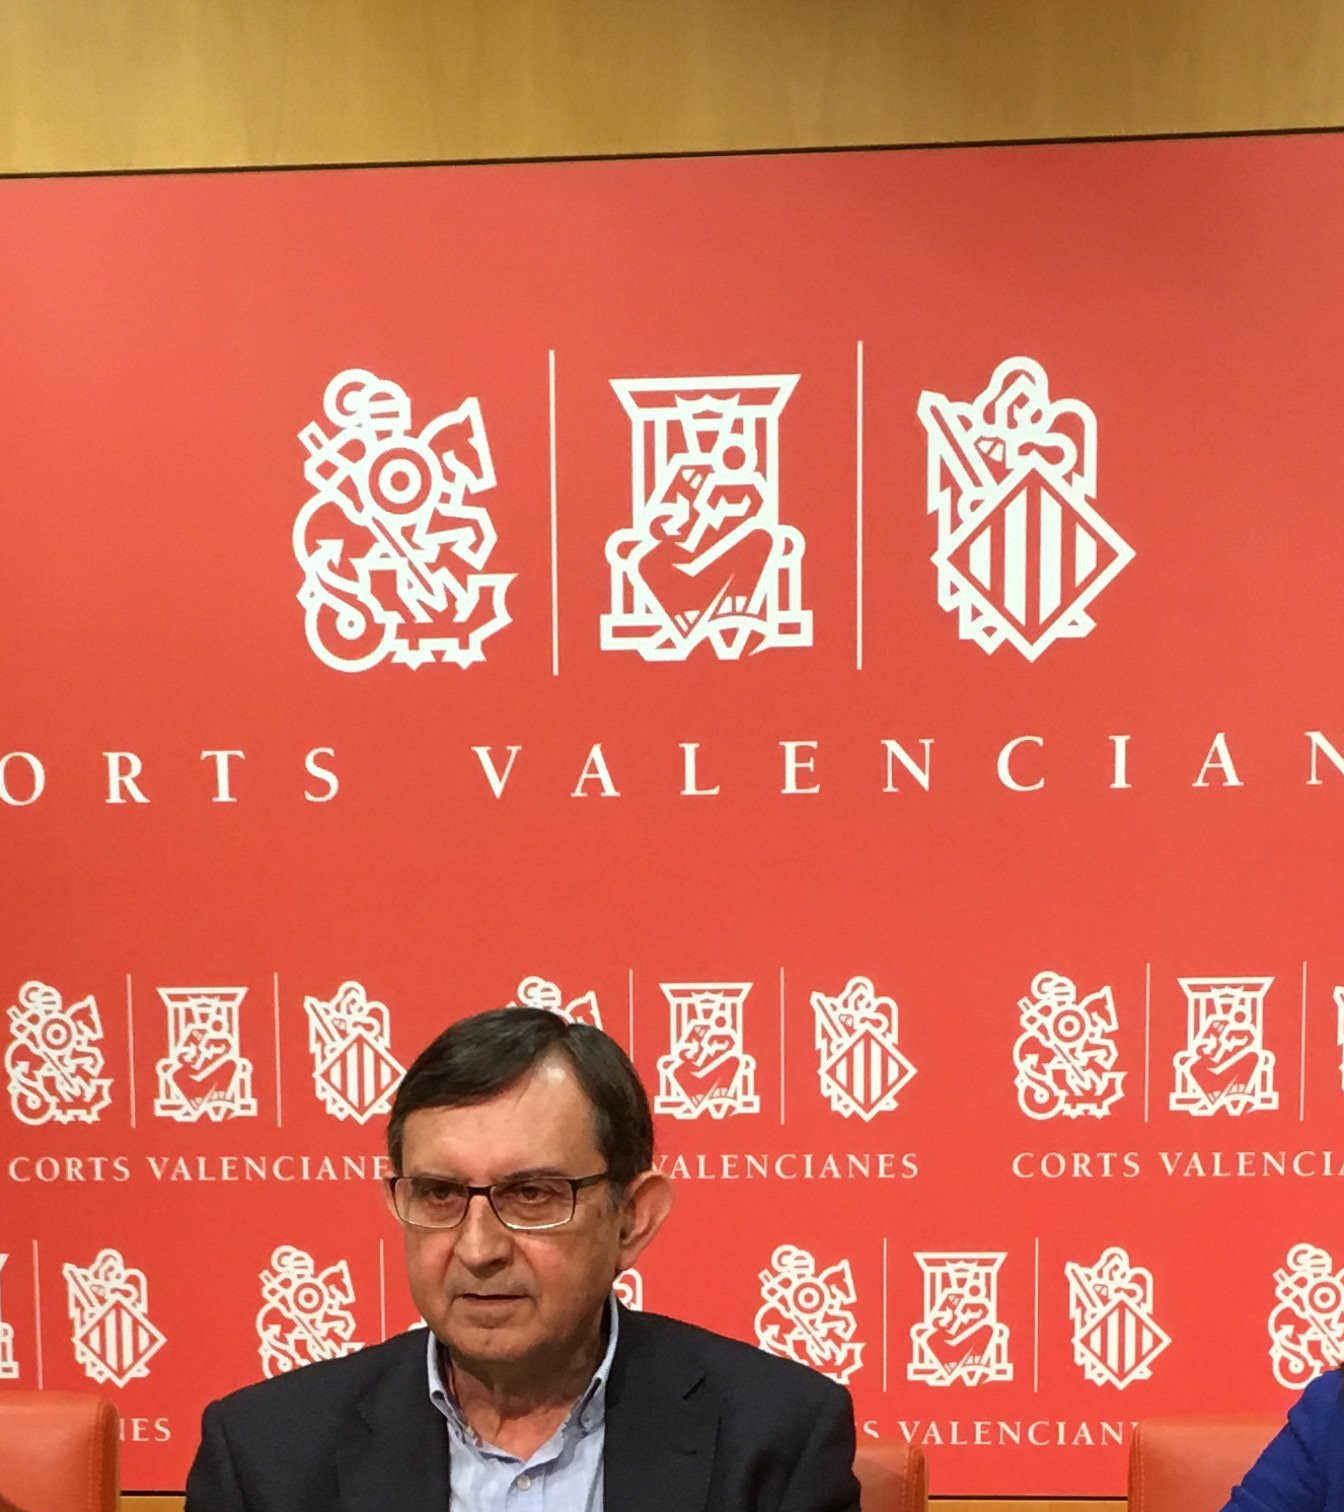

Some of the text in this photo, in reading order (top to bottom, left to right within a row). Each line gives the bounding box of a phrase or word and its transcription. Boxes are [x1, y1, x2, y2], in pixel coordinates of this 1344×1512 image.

[8, 1155, 392, 1182] CORTS VALENCIANE
[1011, 1151, 1140, 1178] CORTS
[898, 1420, 1139, 1446] VALENCIAN
